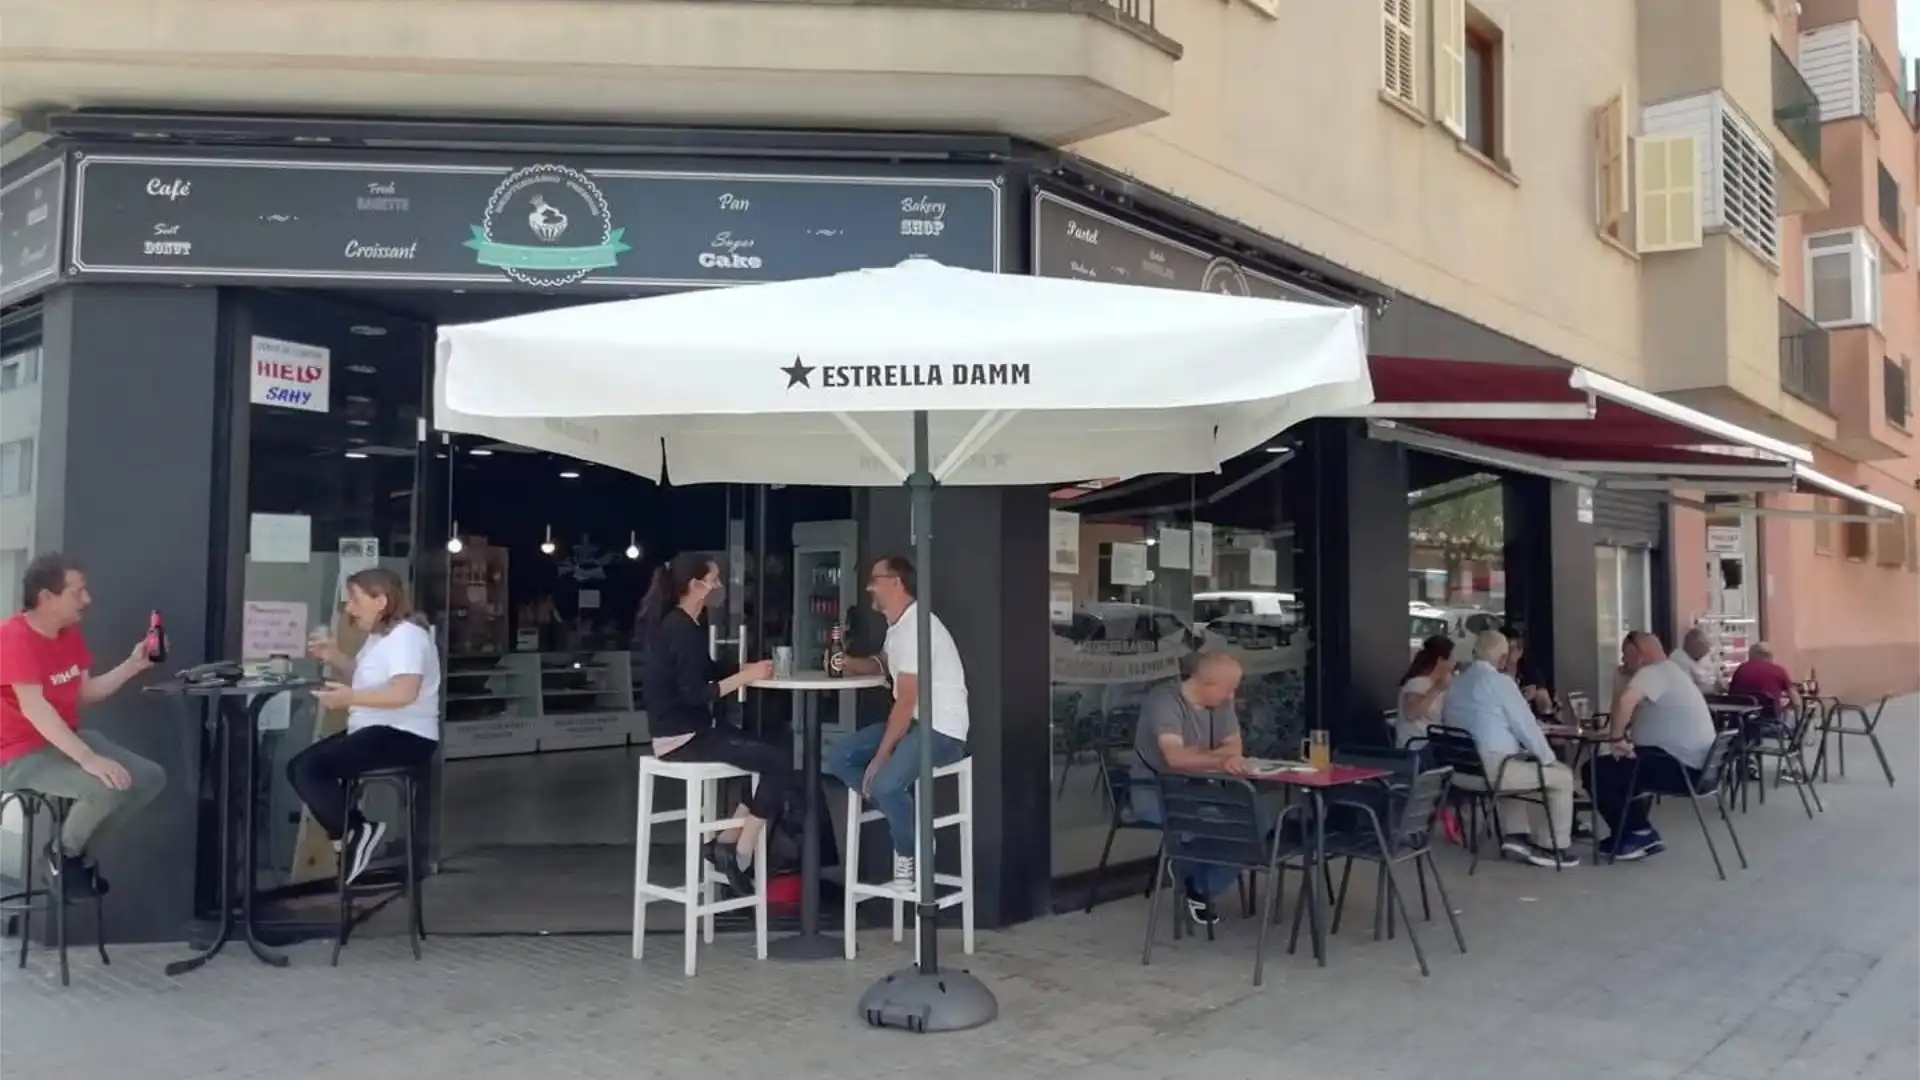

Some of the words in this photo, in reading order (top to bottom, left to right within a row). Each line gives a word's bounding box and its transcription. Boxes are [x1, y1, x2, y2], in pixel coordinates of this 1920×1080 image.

[146, 178, 191, 200] Café
[718, 192, 749, 210] Pan
[901, 195, 946, 219] Bakery
[901, 220, 944, 236] SHOP
[345, 239, 416, 259] Croissant
[699, 253, 762, 268] Cake
[257, 361, 322, 383] HIELO
[822, 365, 943, 387] ESTRELLA
[952, 363, 1030, 385] DAMM
[266, 387, 311, 404] SAHY
